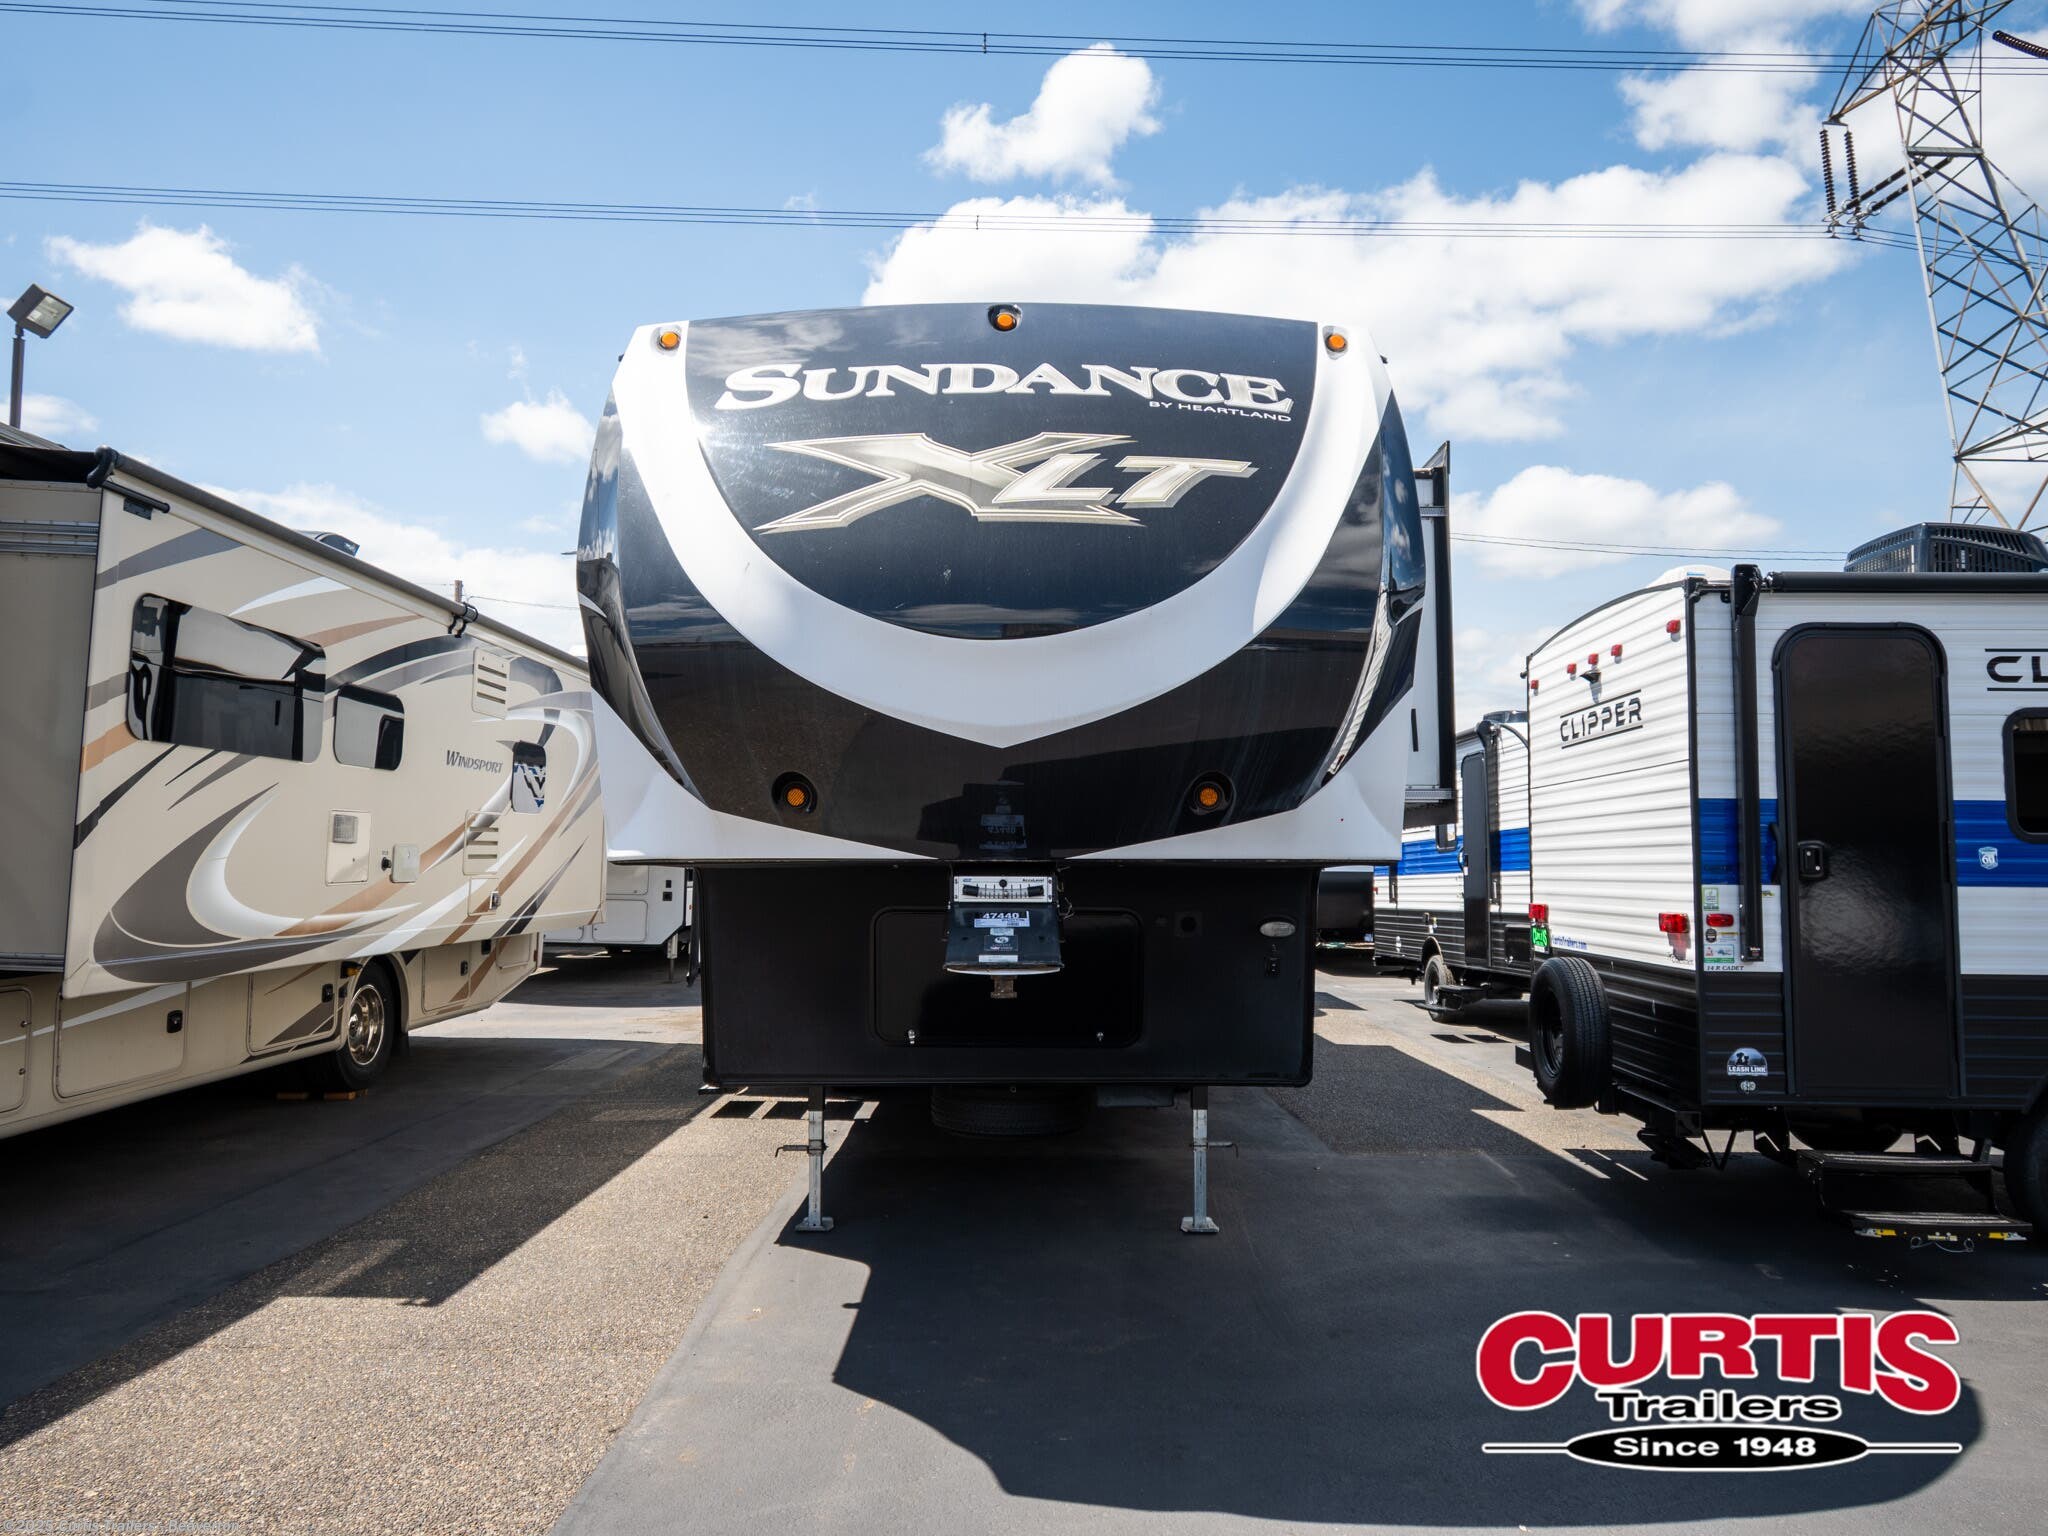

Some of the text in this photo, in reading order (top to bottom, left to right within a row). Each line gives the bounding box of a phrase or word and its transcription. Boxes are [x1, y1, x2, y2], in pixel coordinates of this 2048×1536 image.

[715, 363, 1293, 414] SUNDANCE
[1149, 401, 1292, 422] BY HEARTLAND
[754, 431, 1259, 534] XLT
[1559, 697, 1642, 742] CLIPPER
[446, 750, 503, 773] WINDSPORT
